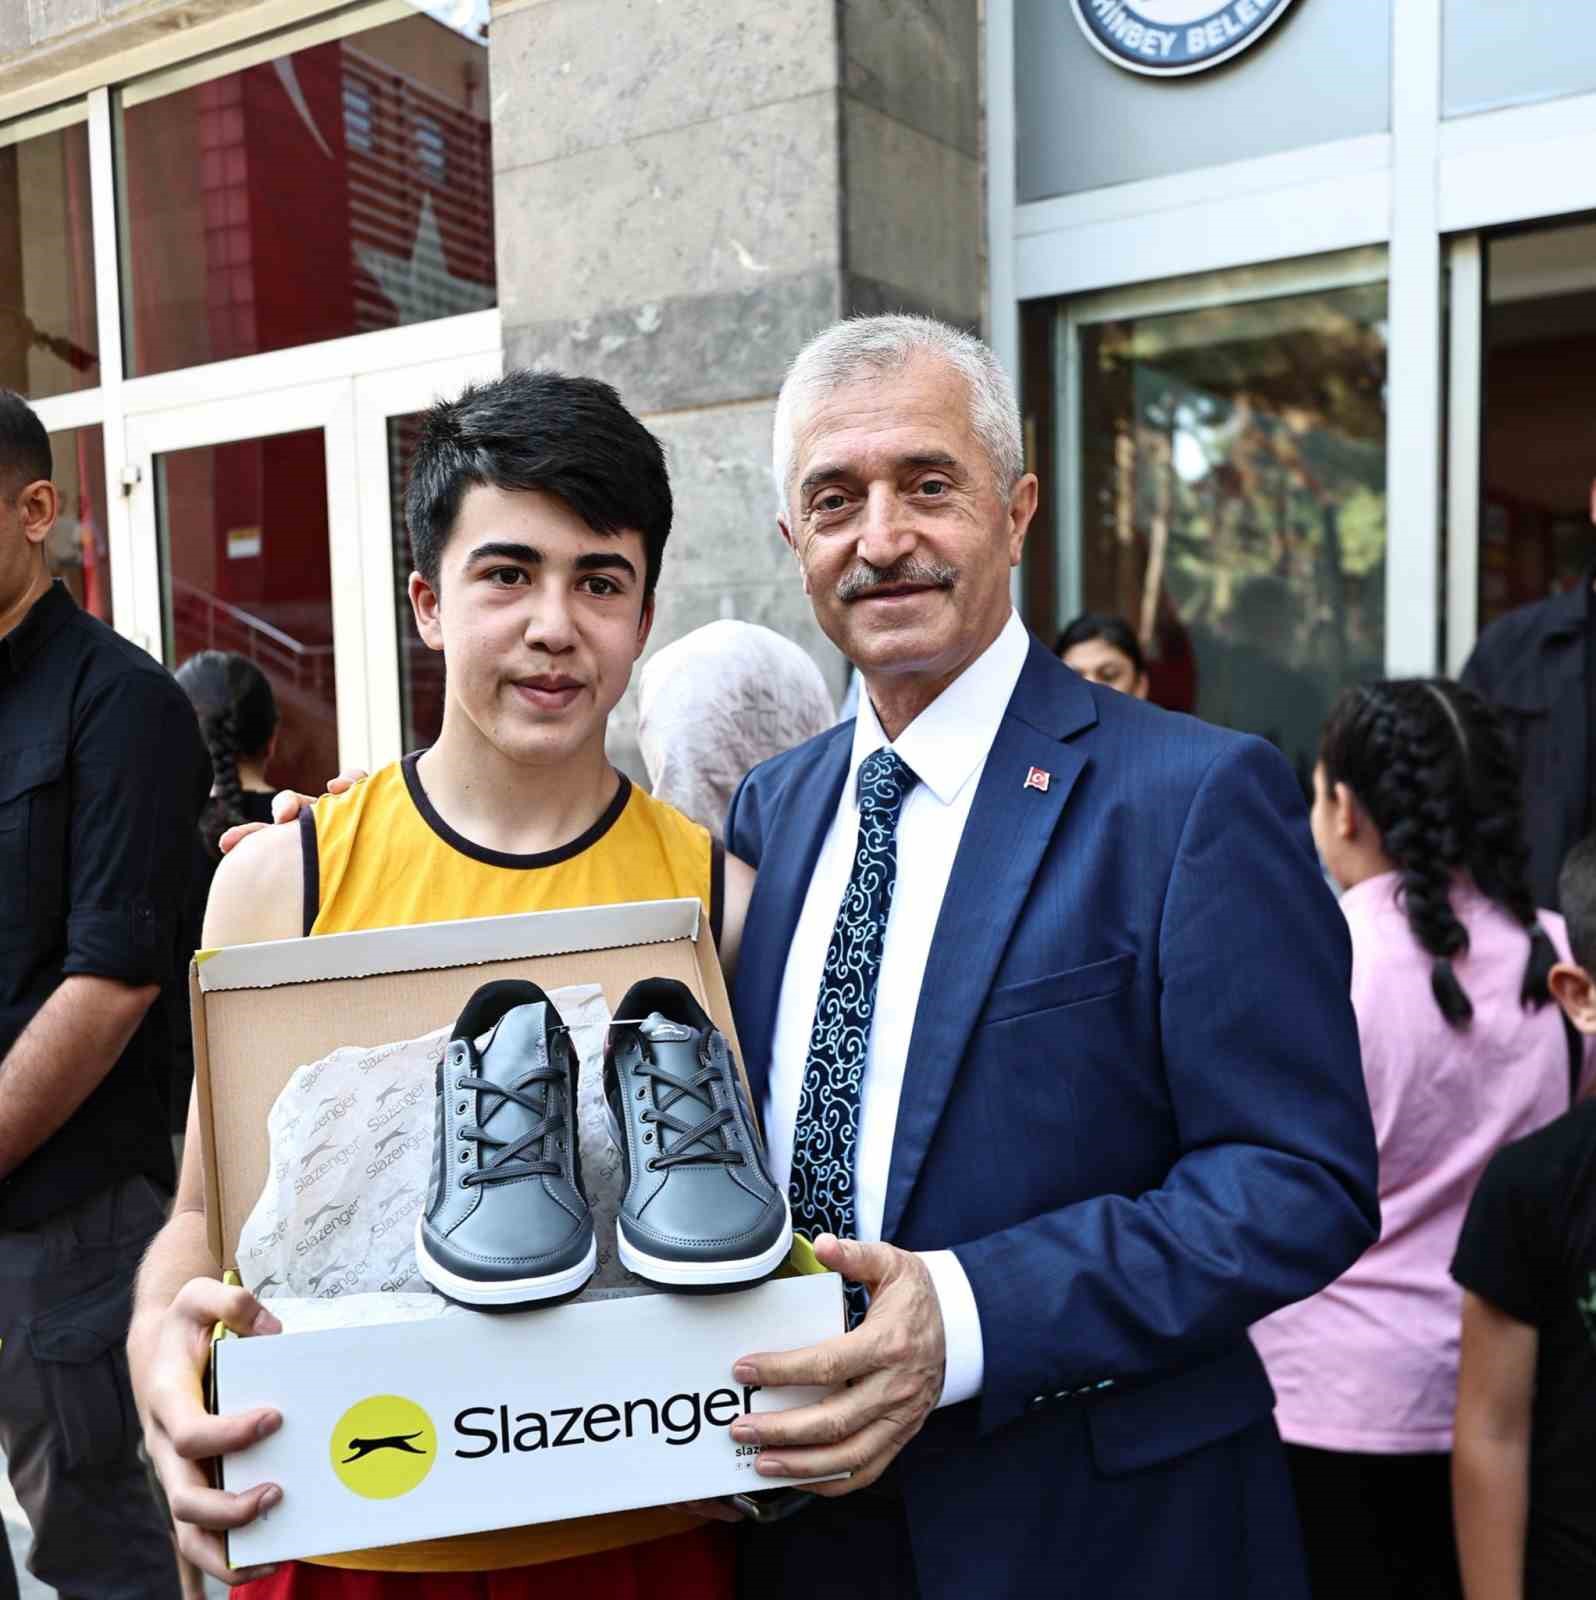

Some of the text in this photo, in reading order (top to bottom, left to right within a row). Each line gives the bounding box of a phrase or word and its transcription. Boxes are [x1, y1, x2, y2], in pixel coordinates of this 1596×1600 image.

[294, 1136, 360, 1196] Slazenger
[365, 1127, 431, 1180] Slazenger
[295, 1194, 361, 1257] Slazenger
[454, 1385, 762, 1459] Slazenger
[735, 1445, 764, 1457] slaz
